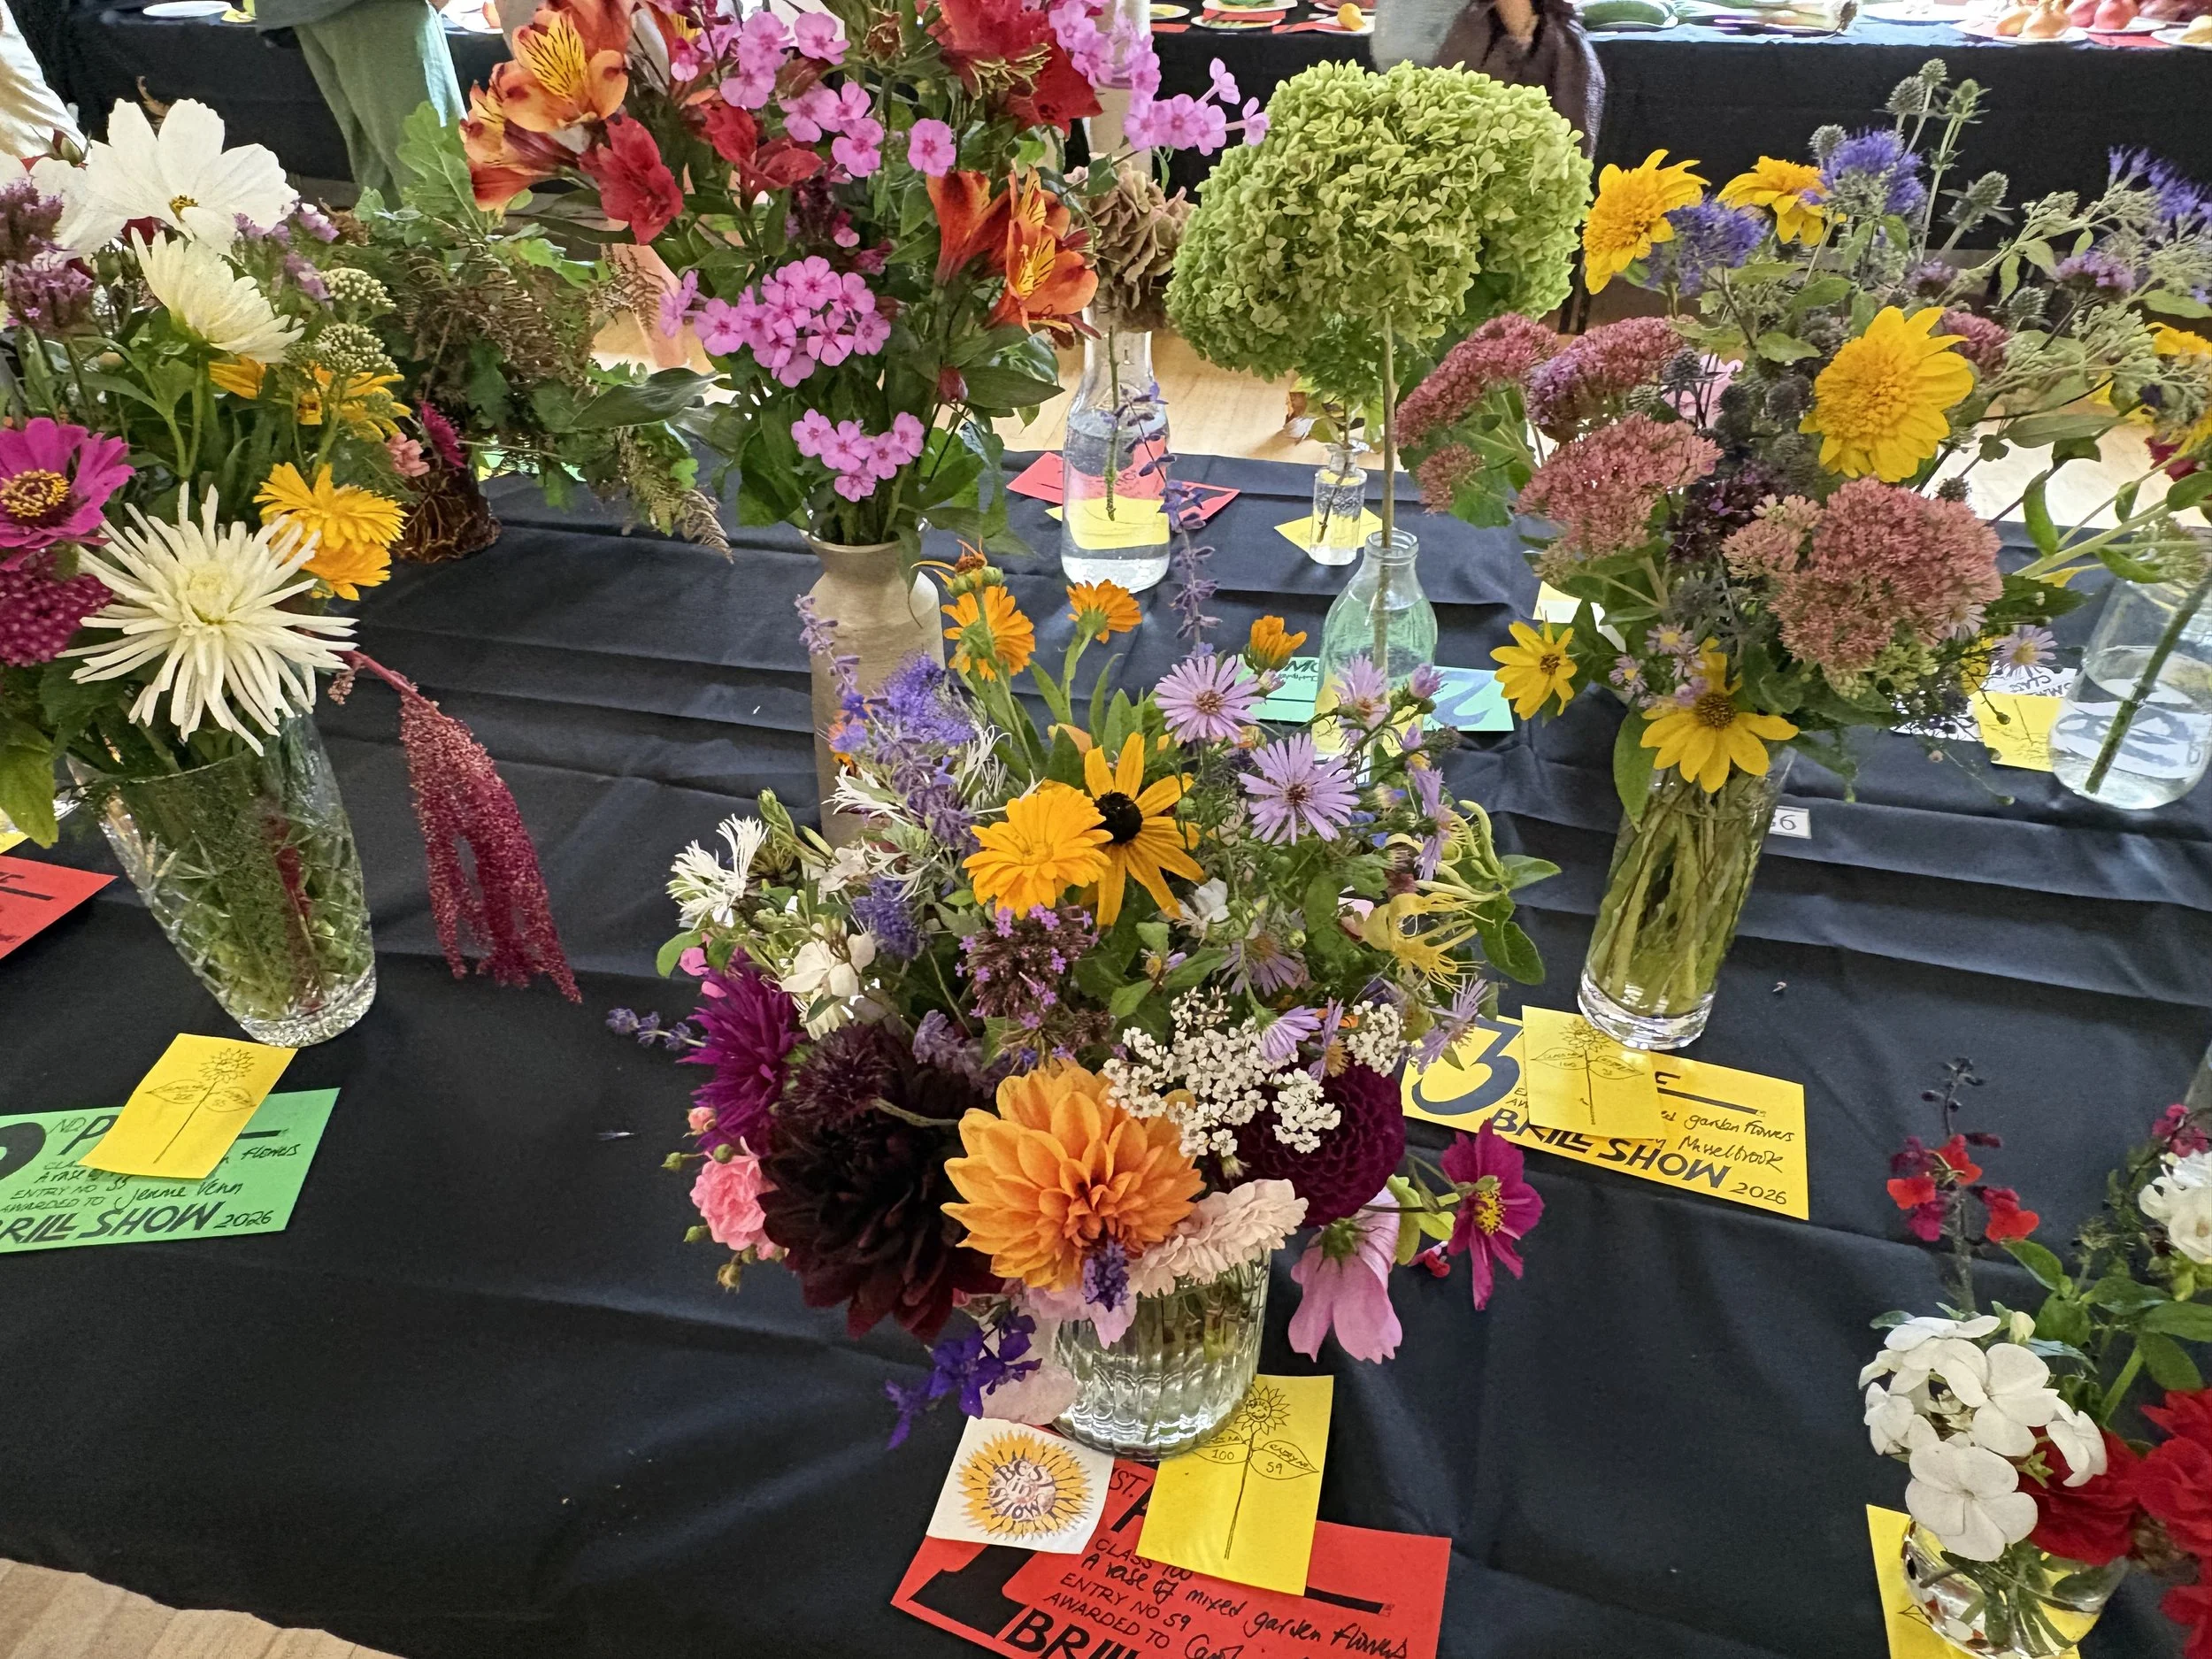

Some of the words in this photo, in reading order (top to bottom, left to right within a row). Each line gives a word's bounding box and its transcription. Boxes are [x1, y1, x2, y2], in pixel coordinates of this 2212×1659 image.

[1412, 1017, 1524, 1115] 3
[1684, 1114, 1740, 1131] garden
[1596, 1137, 1733, 1189] SHOW
[1729, 1182, 1787, 1205] 2026
[10, 1187, 71, 1199] ENTRY
[83, 1196, 105, 1208] TO
[73, 1201, 227, 1240] SHOW
[212, 1210, 274, 1229] 2026
[1210, 1448, 1235, 1462] 100
[1265, 1461, 1284, 1475] 59
[1094, 1539, 1154, 1571] CLASS
[1059, 1572, 1130, 1606] ENTRY
[1129, 1601, 1161, 1620] NO
[1163, 1612, 1193, 1632] 59
[1080, 1553, 1101, 1571] A
[1105, 1563, 1149, 1592] vase
[1185, 1588, 1248, 1617] mixed
[1242, 1611, 1322, 1642] garden
[1042, 1592, 1141, 1636] AWARDED
[1145, 1628, 1171, 1650] TO
